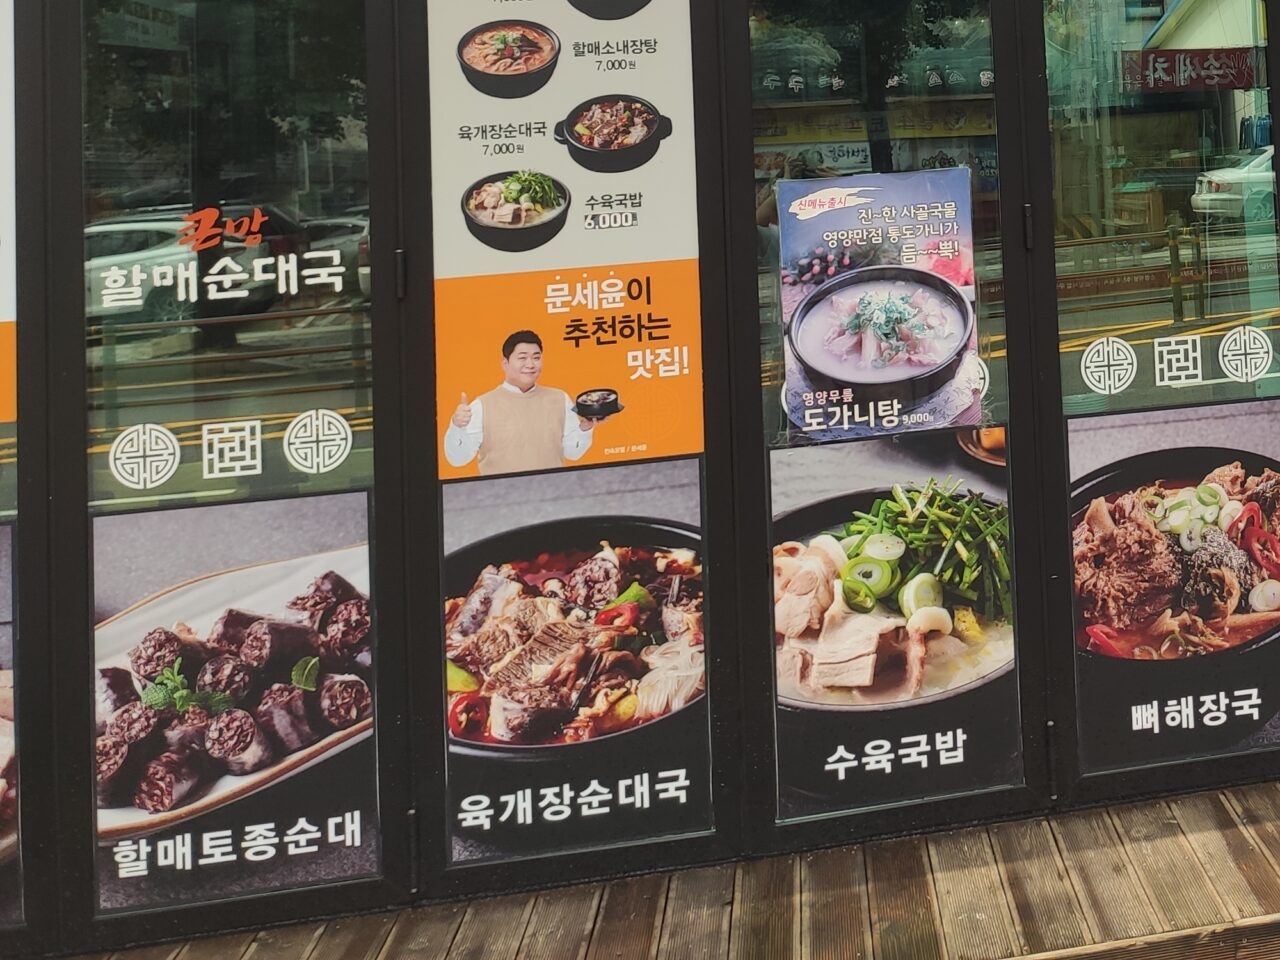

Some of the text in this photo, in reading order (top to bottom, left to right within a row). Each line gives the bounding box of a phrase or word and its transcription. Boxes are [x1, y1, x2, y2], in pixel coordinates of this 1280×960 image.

[572, 39, 658, 57] 할매소내장탕
[595, 59, 636, 71] 7,000원
[458, 122, 548, 141] 육개장순대국
[482, 143, 524, 156] 7,000원
[585, 192, 643, 211] 수육국밥
[798, 196, 847, 211] 신메뉴출시
[858, 201, 958, 225] 진~한 사골국물
[177, 207, 268, 252] 큰맘
[823, 222, 959, 249] 영양만점 통도가니가
[101, 249, 346, 309] 할매순대국
[544, 275, 651, 314] 문세윤이
[563, 313, 671, 348] 추천하는
[627, 346, 689, 380] 맛집!
[802, 388, 854, 407] 영양무릎
[802, 399, 902, 431] 도가니탕
[1130, 688, 1262, 736] 뼈해장국
[824, 728, 968, 781] 수육국밥
[457, 768, 691, 831] 육개장순대국
[112, 810, 363, 879] 할매토종순대
